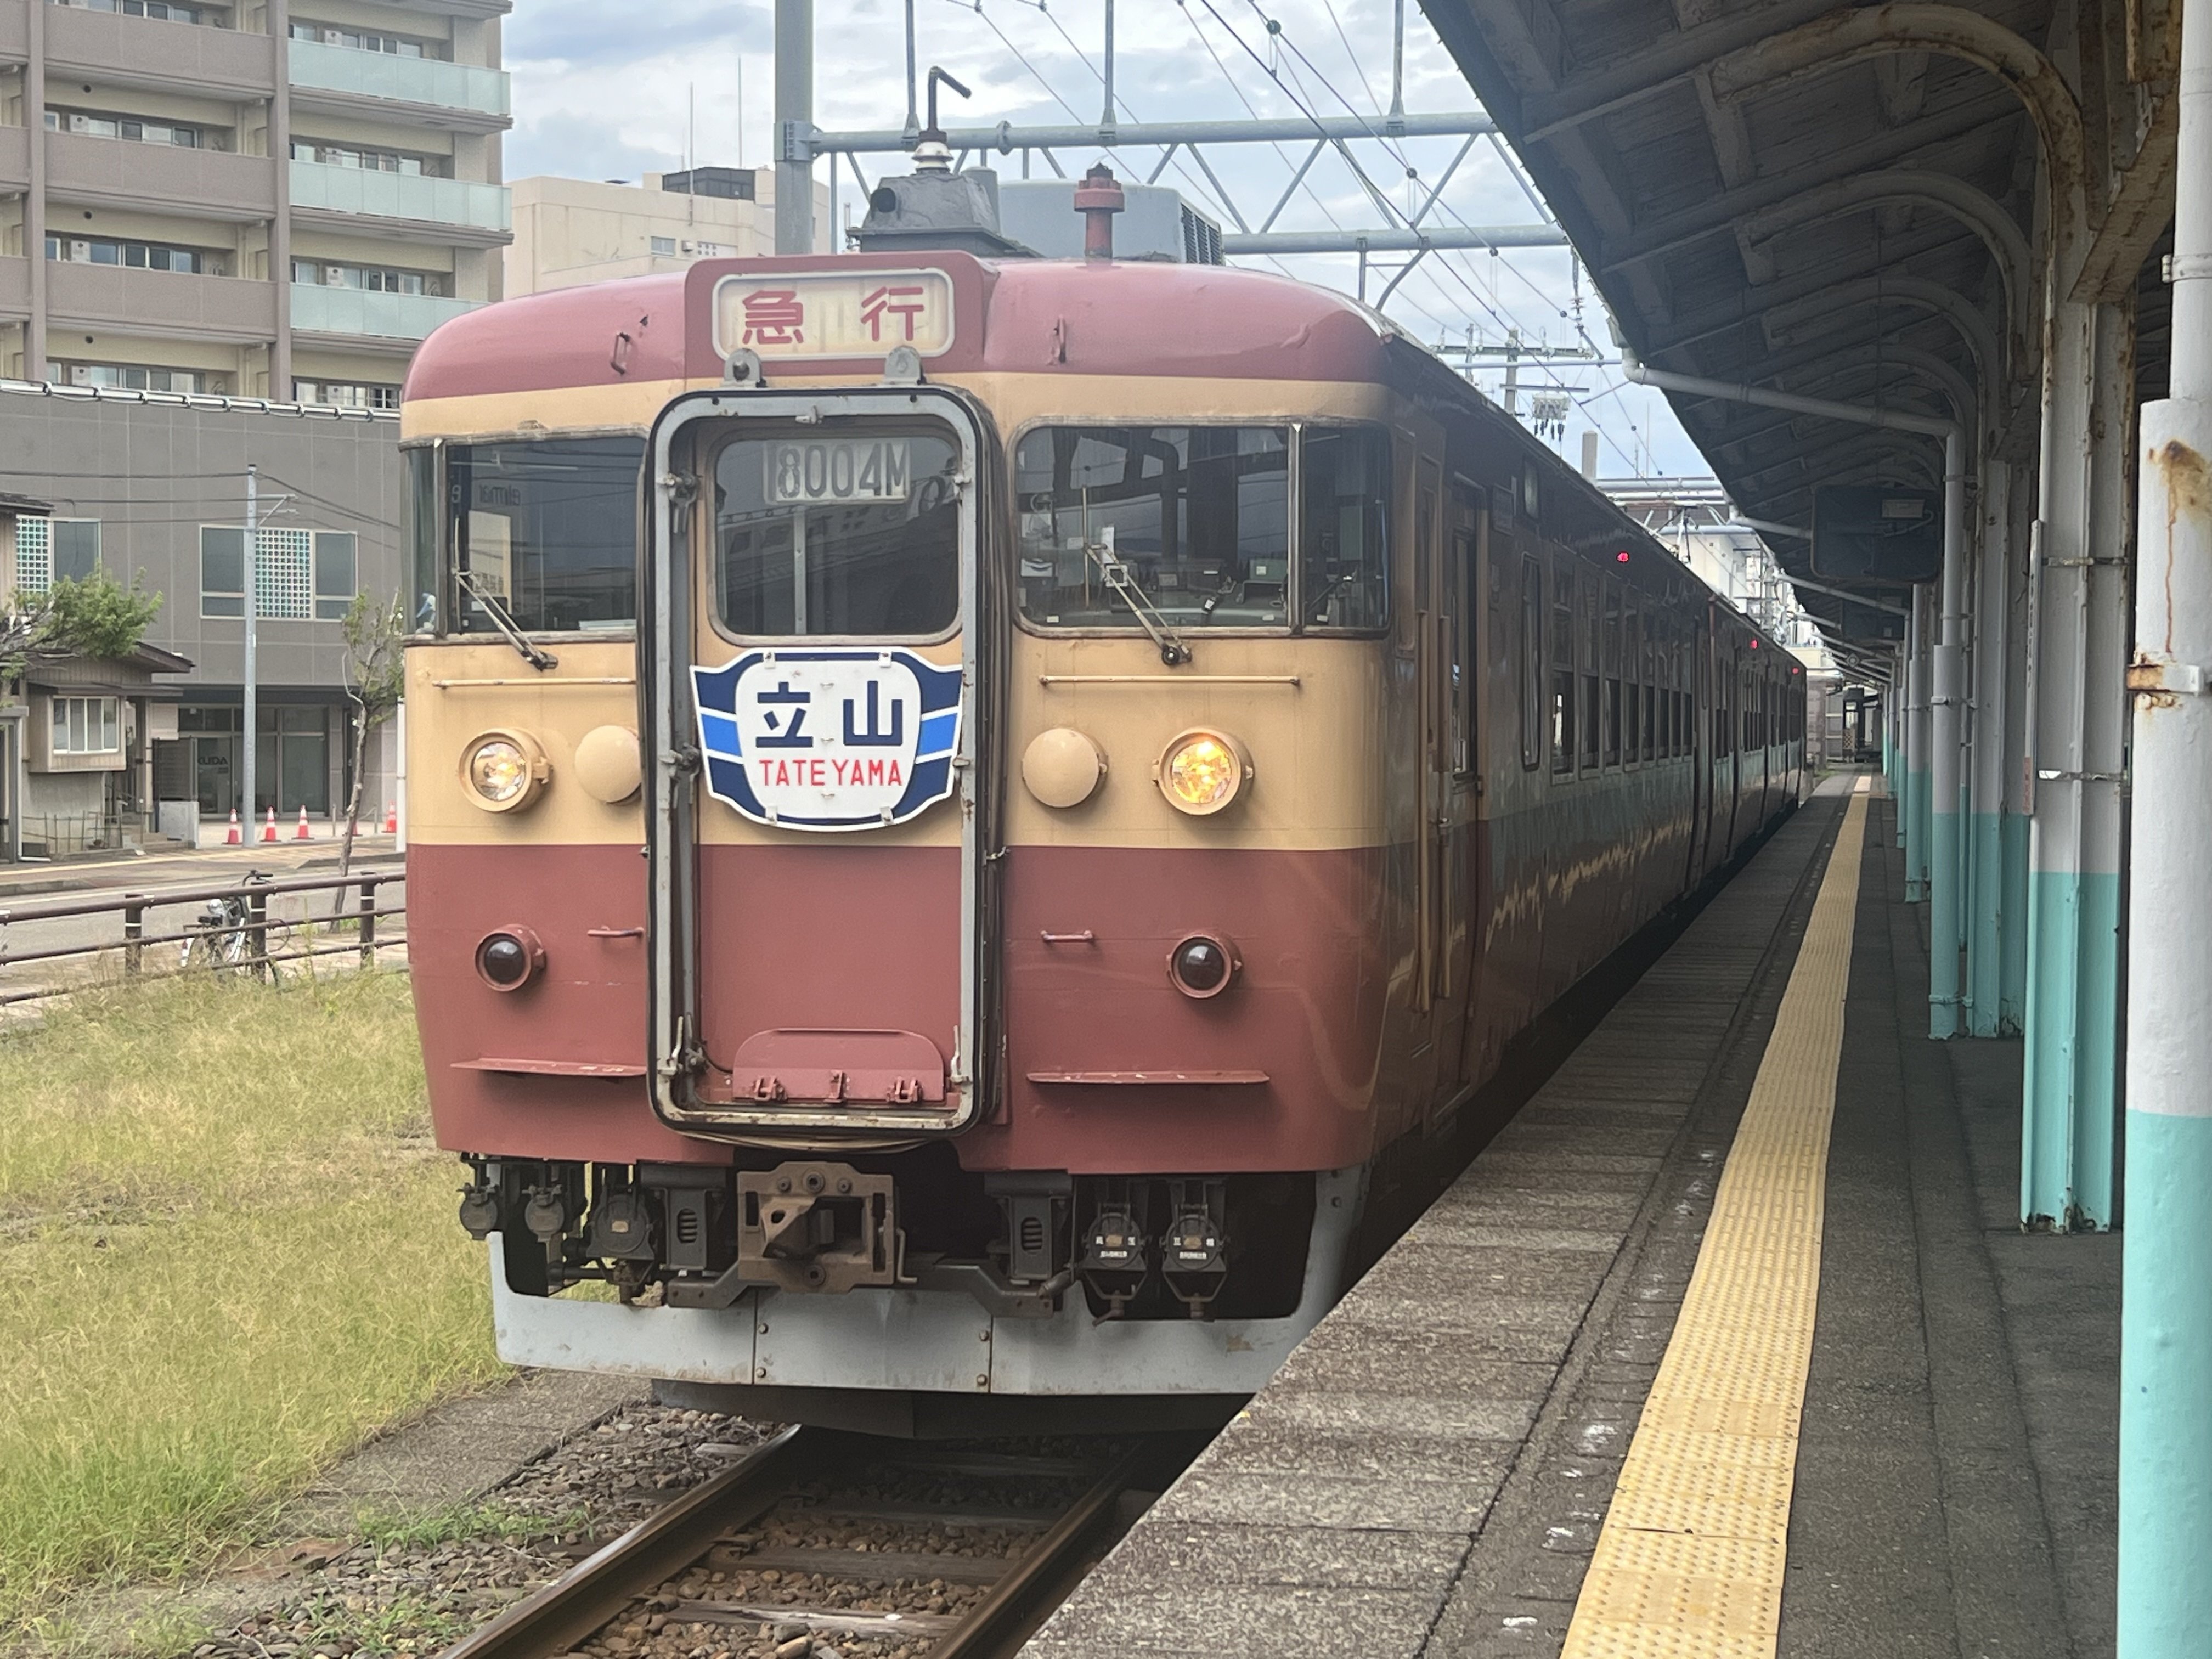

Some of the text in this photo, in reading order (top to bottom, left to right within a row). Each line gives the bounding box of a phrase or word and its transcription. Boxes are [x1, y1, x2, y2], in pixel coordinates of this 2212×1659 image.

[742, 286, 925, 345] 急行
[777, 443, 906, 499] 8004M
[756, 680, 903, 748] 立山
[759, 759, 902, 786] TATEYAMA
